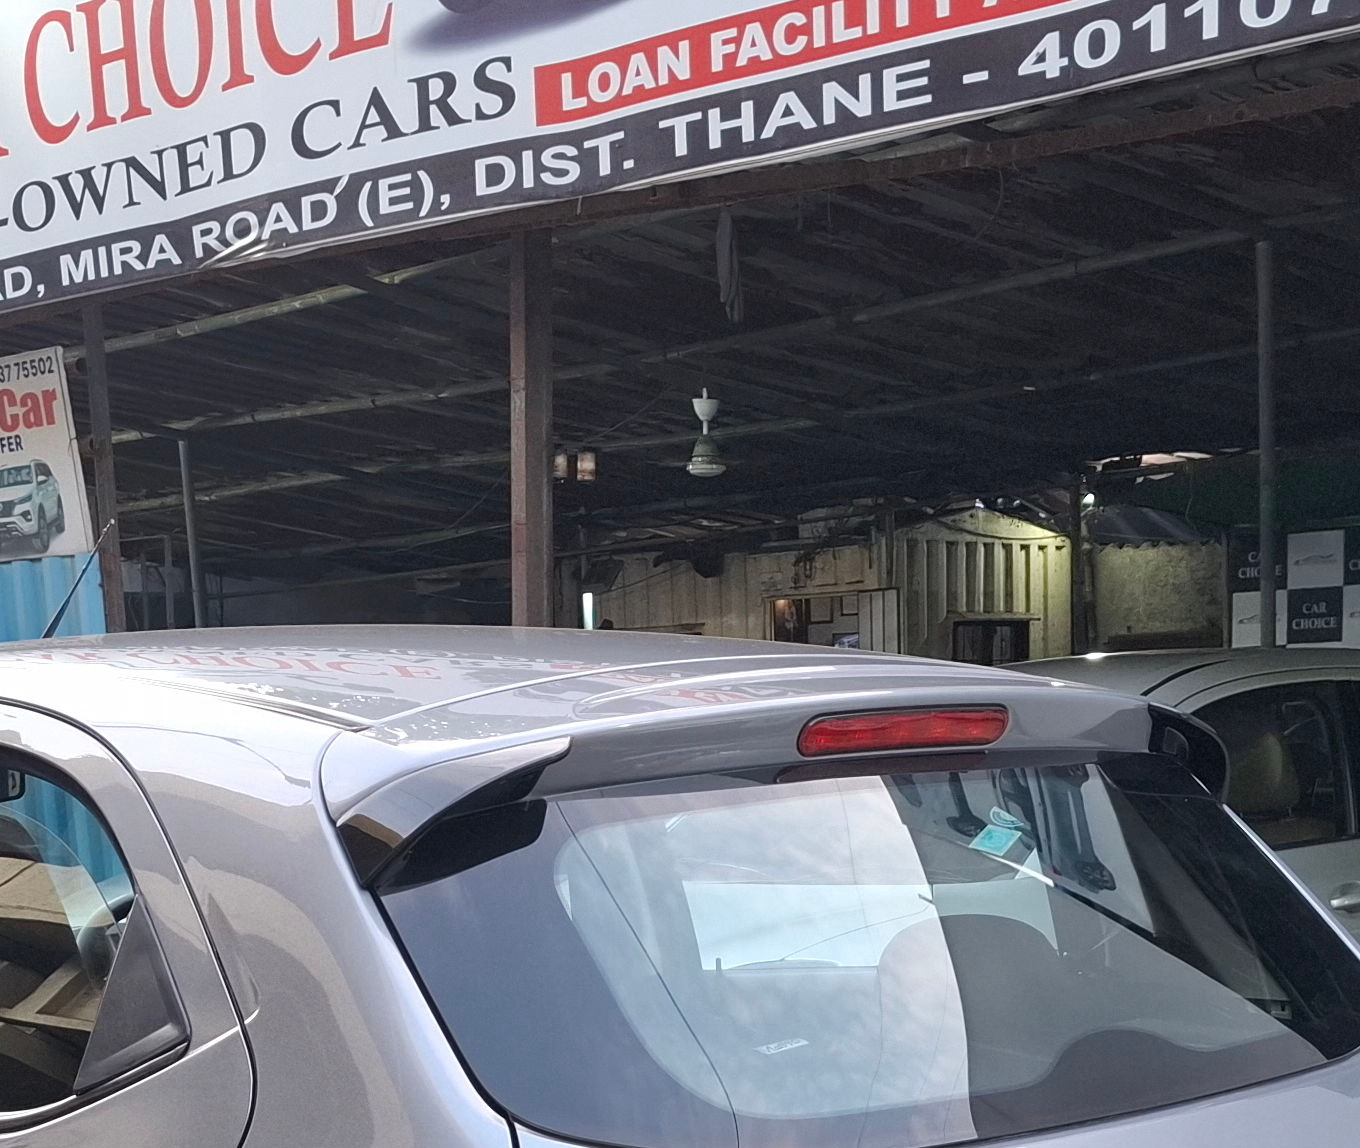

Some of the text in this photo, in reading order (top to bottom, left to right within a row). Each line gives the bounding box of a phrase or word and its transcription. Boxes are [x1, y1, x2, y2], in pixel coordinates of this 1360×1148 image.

[290, 56, 517, 160] CARS
[561, 39, 691, 112] LOAN
[59, 233, 181, 287] MIRA
[191, 191, 343, 259] ROAD
[357, 170, 451, 229] (E),
[474, 131, 636, 197] DIST.
[659, 59, 933, 158] THANE
[1292, 616, 1338, 630] CHOICE
[1302, 602, 1327, 615] CAR
